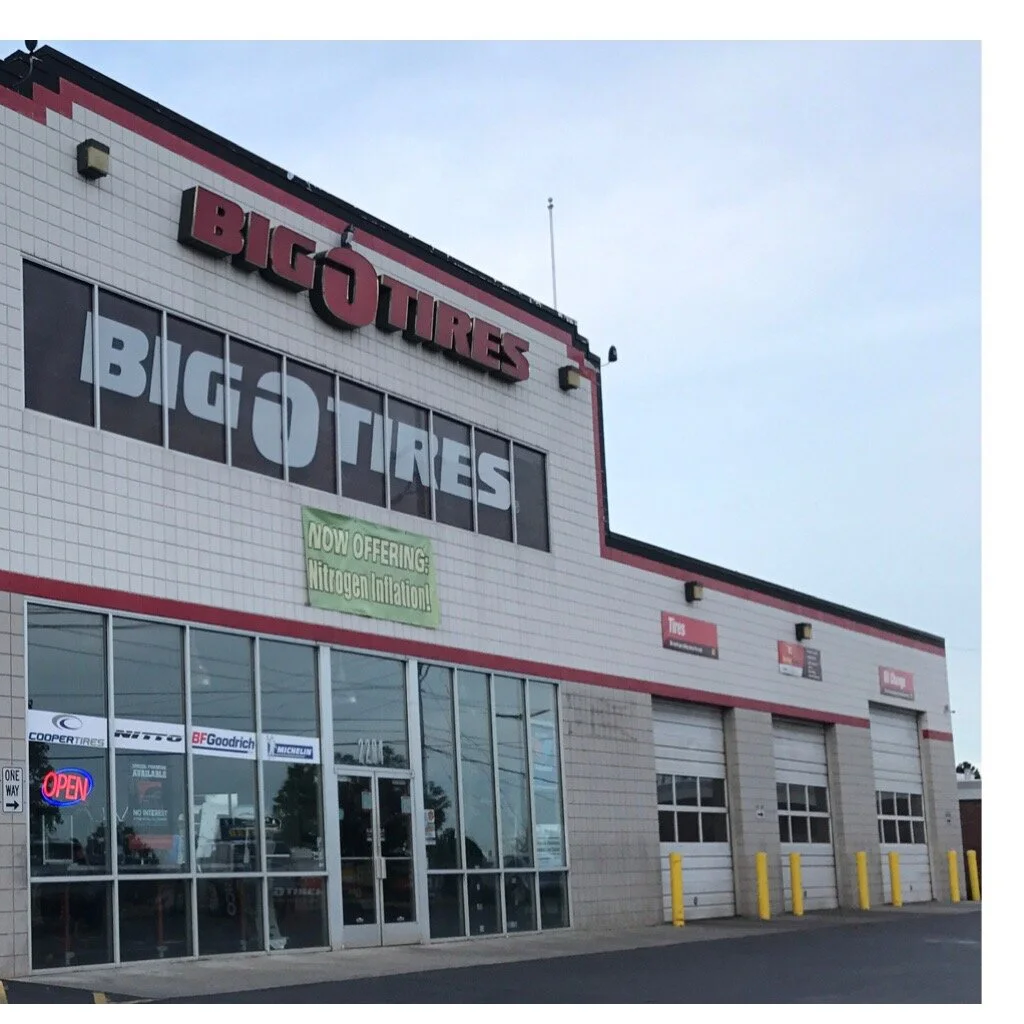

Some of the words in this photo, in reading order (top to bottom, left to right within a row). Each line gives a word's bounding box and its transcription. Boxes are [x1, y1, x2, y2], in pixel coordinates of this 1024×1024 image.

[178, 185, 318, 292] BIG
[309, 246, 380, 330] O
[376, 274, 530, 384] TIRES
[80, 311, 243, 429] BIG
[252, 371, 320, 468] O
[326, 396, 513, 511] TIRES
[307, 521, 350, 556] NOW
[352, 530, 430, 577] OFFERING:
[307, 557, 369, 602] Nitrogen
[370, 570, 432, 613] Inflation!
[114, 729, 183, 743] NITTO
[191, 731, 256, 750] BFGoodrich
[276, 744, 313, 757] MICHELIN
[4, 768, 21, 783] ONE
[43, 770, 89, 802] OPEN
[5, 784, 20, 798] WAY
